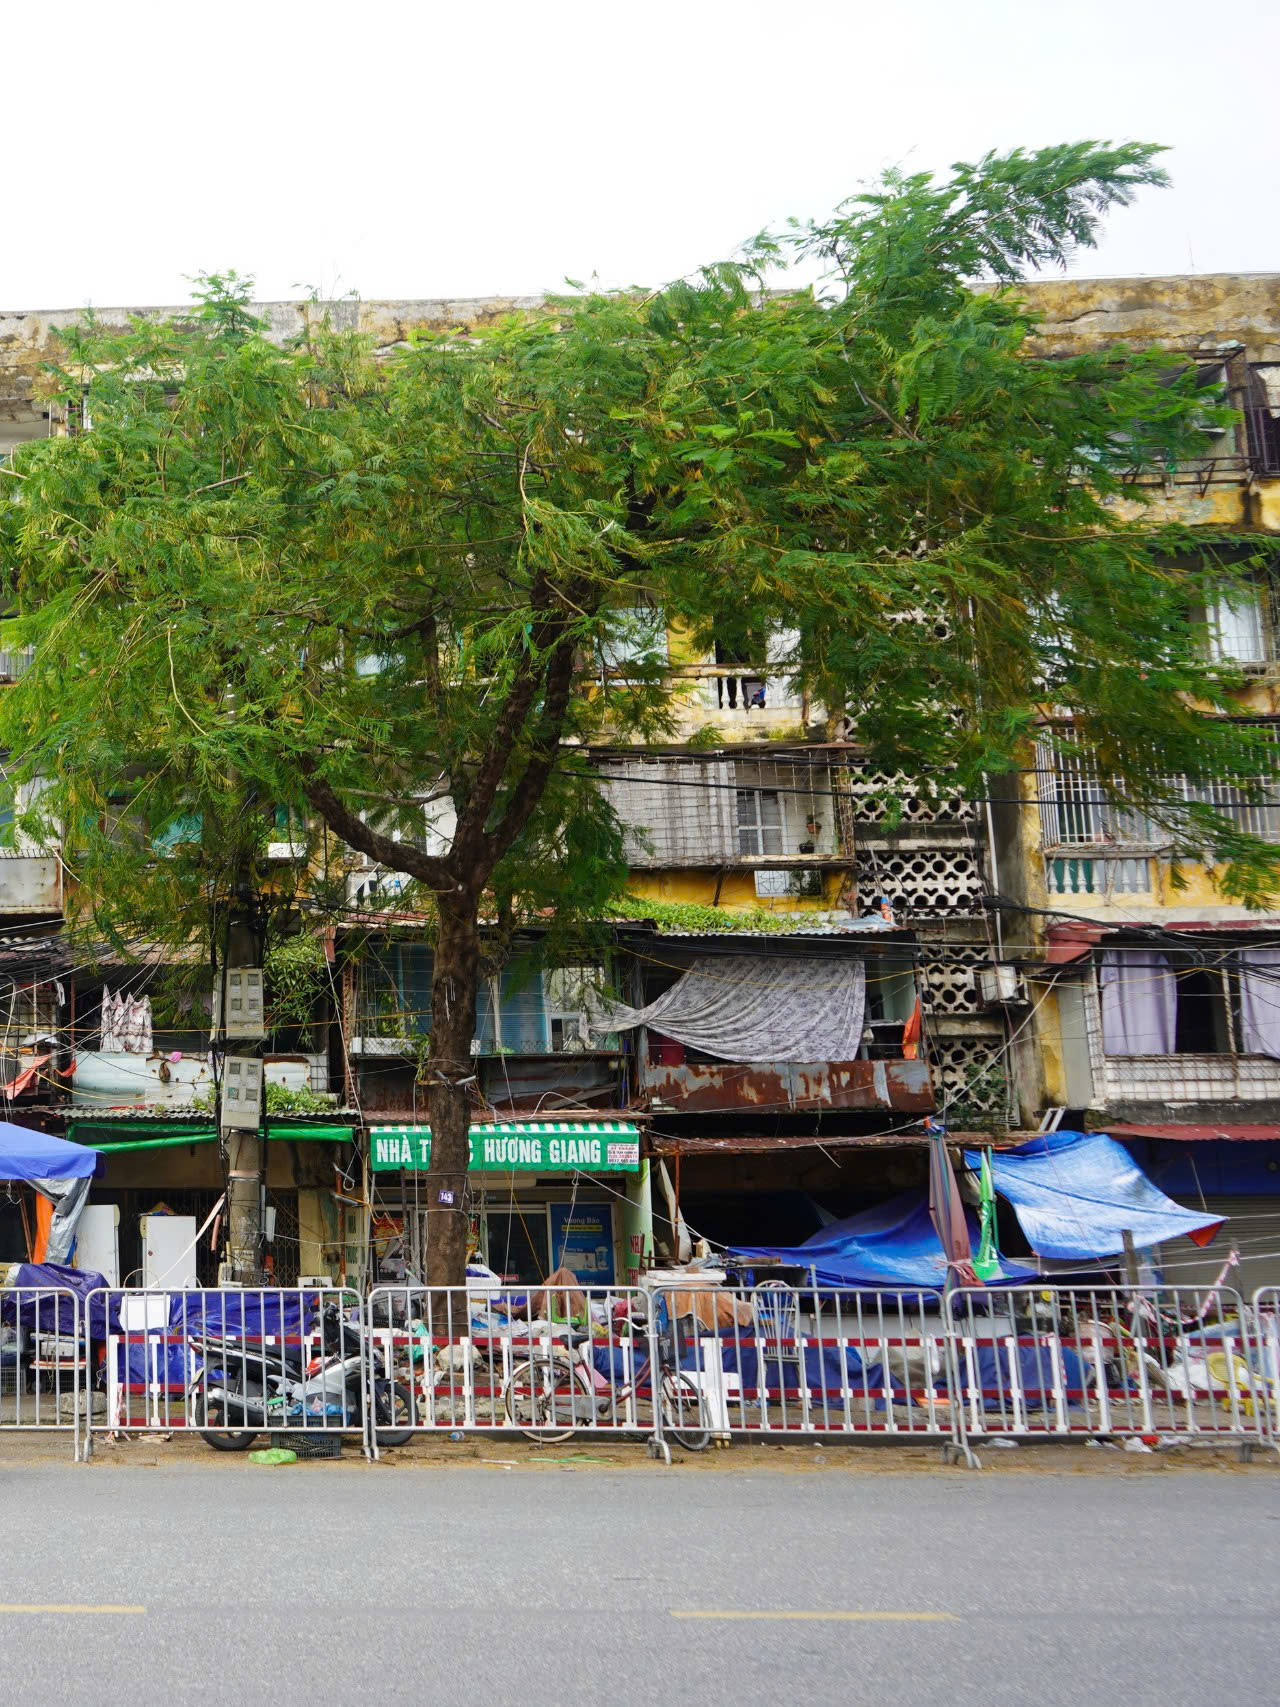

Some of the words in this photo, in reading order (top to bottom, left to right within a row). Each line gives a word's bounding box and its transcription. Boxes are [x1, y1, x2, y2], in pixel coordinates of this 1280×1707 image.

[376, 1135, 412, 1163] NHÀ
[549, 1139, 601, 1164] GIANG
[439, 1191, 453, 1202] 143
